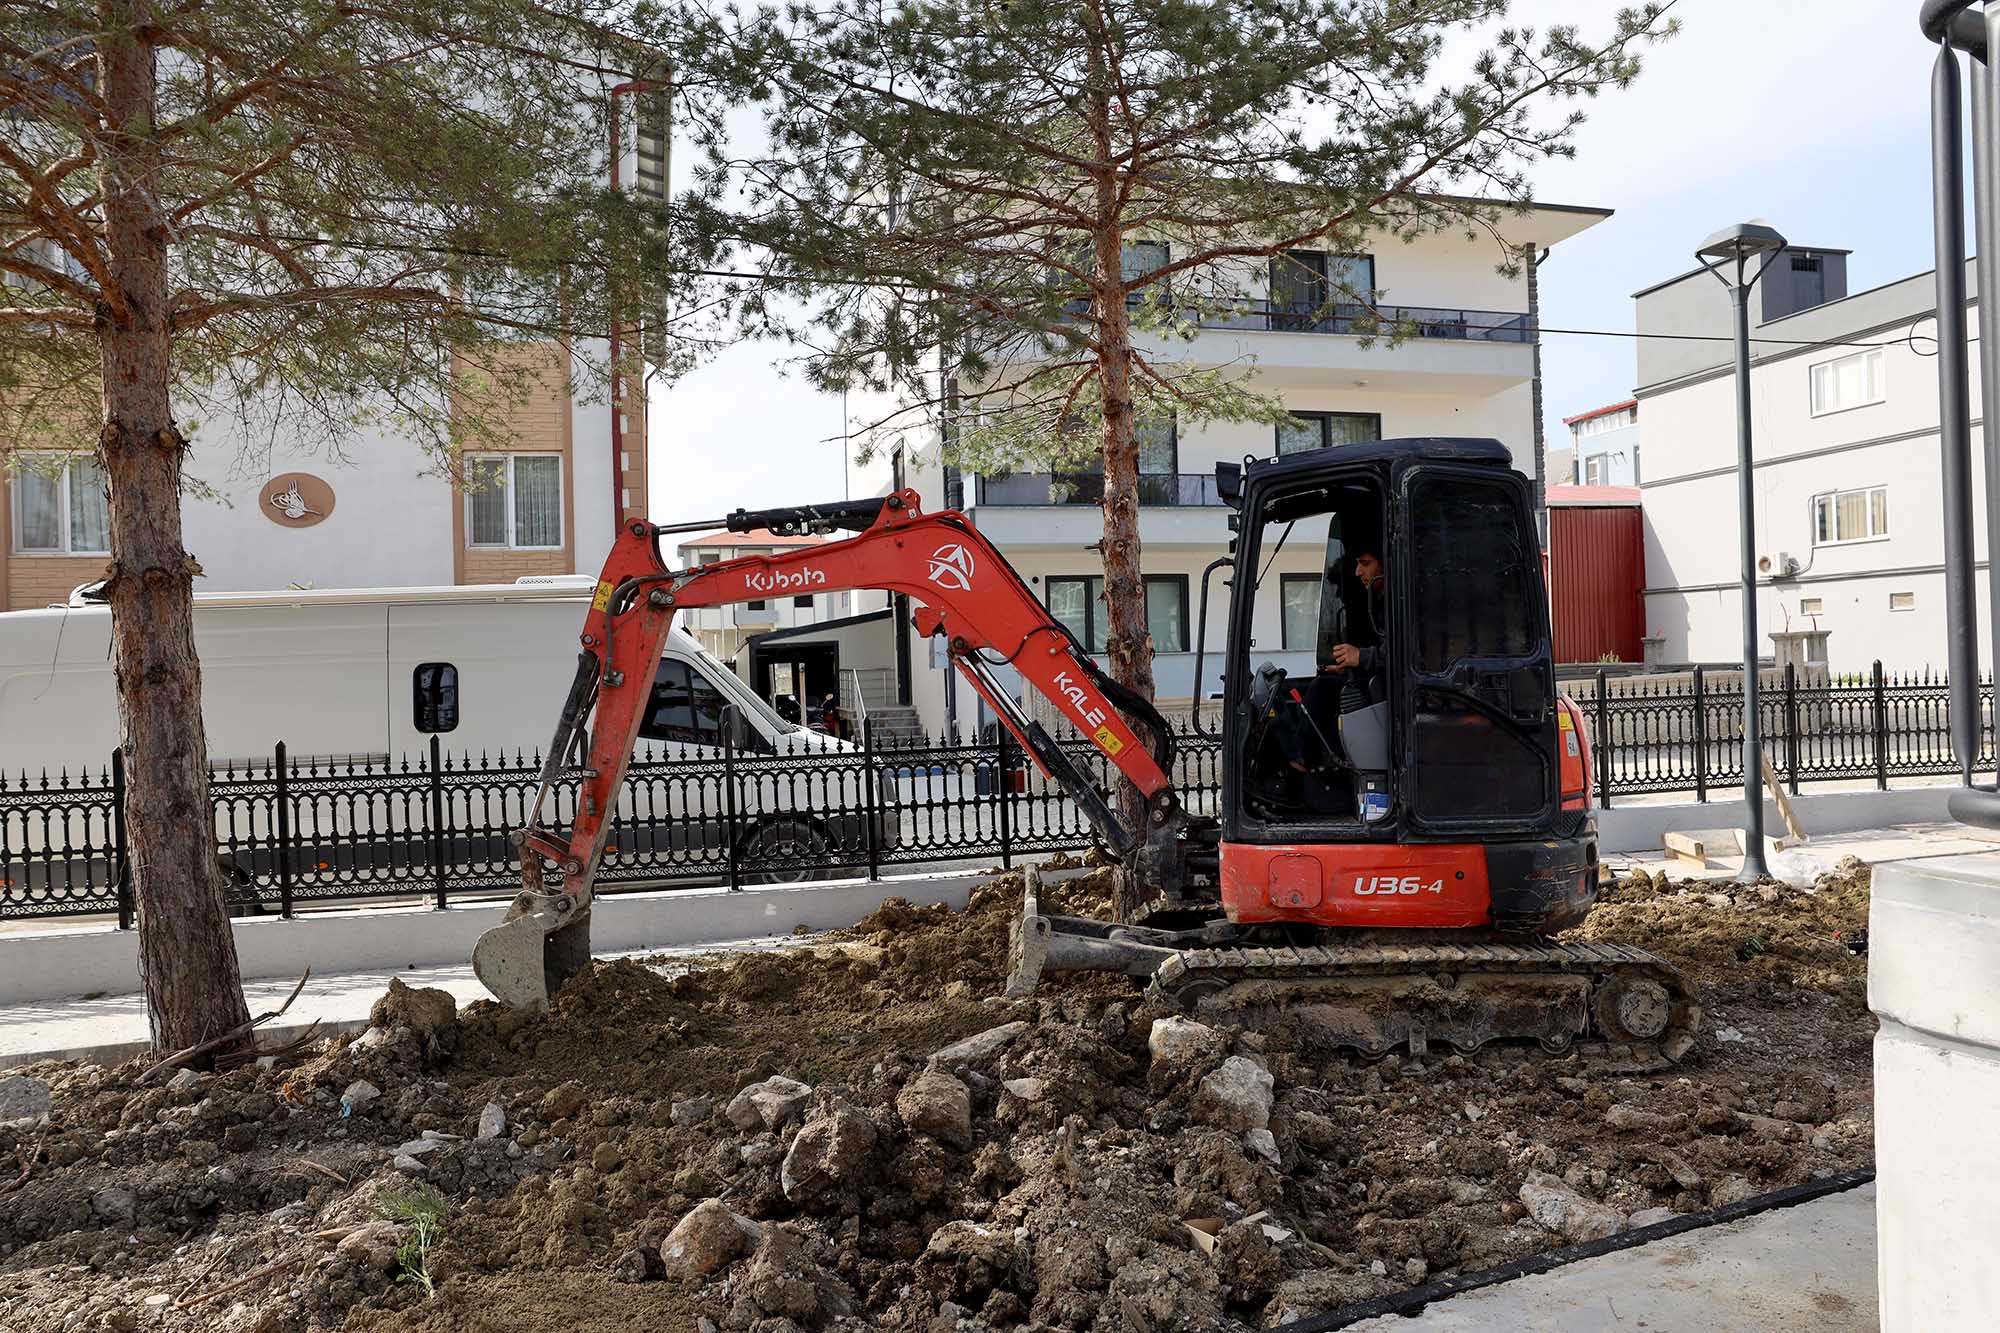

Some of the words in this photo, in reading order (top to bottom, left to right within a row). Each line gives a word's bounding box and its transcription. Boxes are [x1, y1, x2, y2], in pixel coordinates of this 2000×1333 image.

[745, 566, 826, 592] Kubota
[1053, 671, 1107, 729] KALE
[1353, 876, 1444, 896] U36-4
